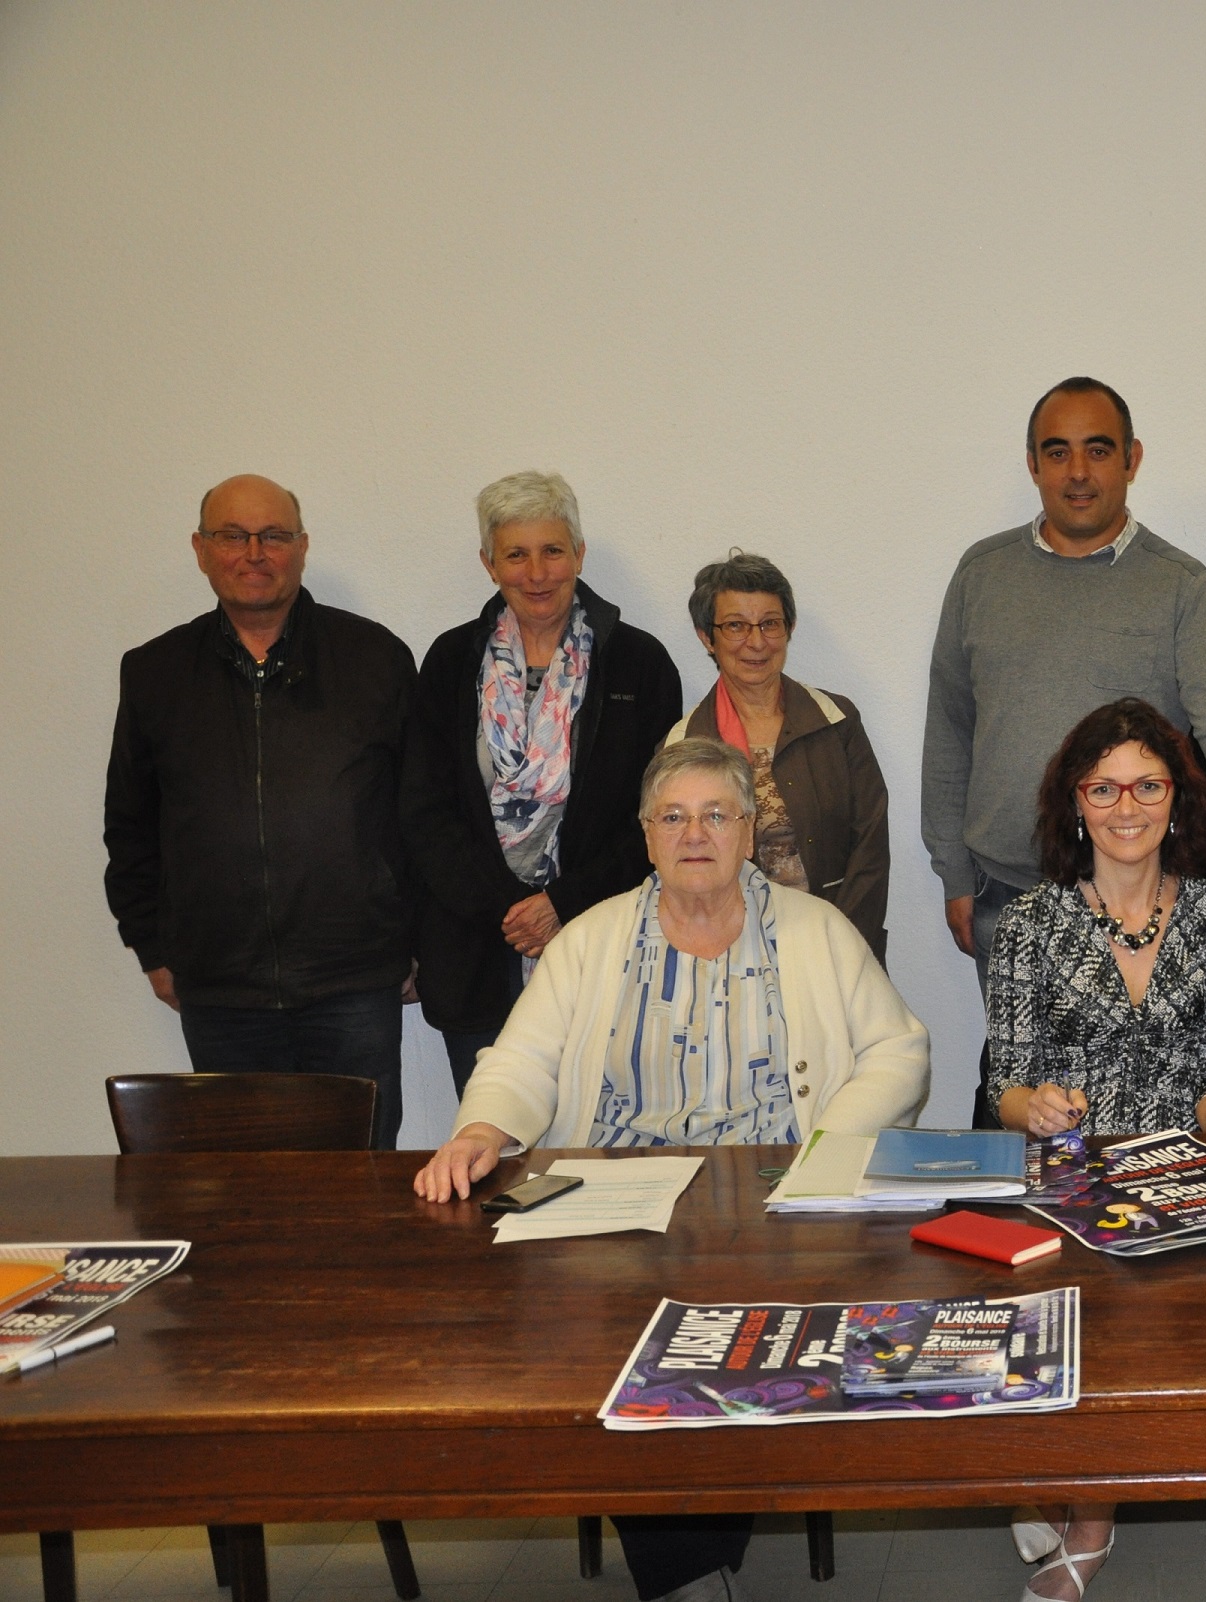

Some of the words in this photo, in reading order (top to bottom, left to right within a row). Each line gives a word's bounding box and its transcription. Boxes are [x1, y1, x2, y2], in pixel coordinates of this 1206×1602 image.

[1111, 1176, 1169, 1189] Dimanche
[1165, 1171, 1181, 1179] 6
[1182, 1168, 1204, 1177] mai
[1151, 1198, 1179, 1207] aux
[782, 1310, 802, 1323] 2018
[934, 1310, 1013, 1324] PLAISANCE
[777, 1323, 798, 1334] mai
[658, 1309, 743, 1369] PLAISANCE
[763, 1334, 793, 1342] 6
[940, 1339, 1001, 1348] BOURSE
[760, 1340, 791, 1369] Dimanche
